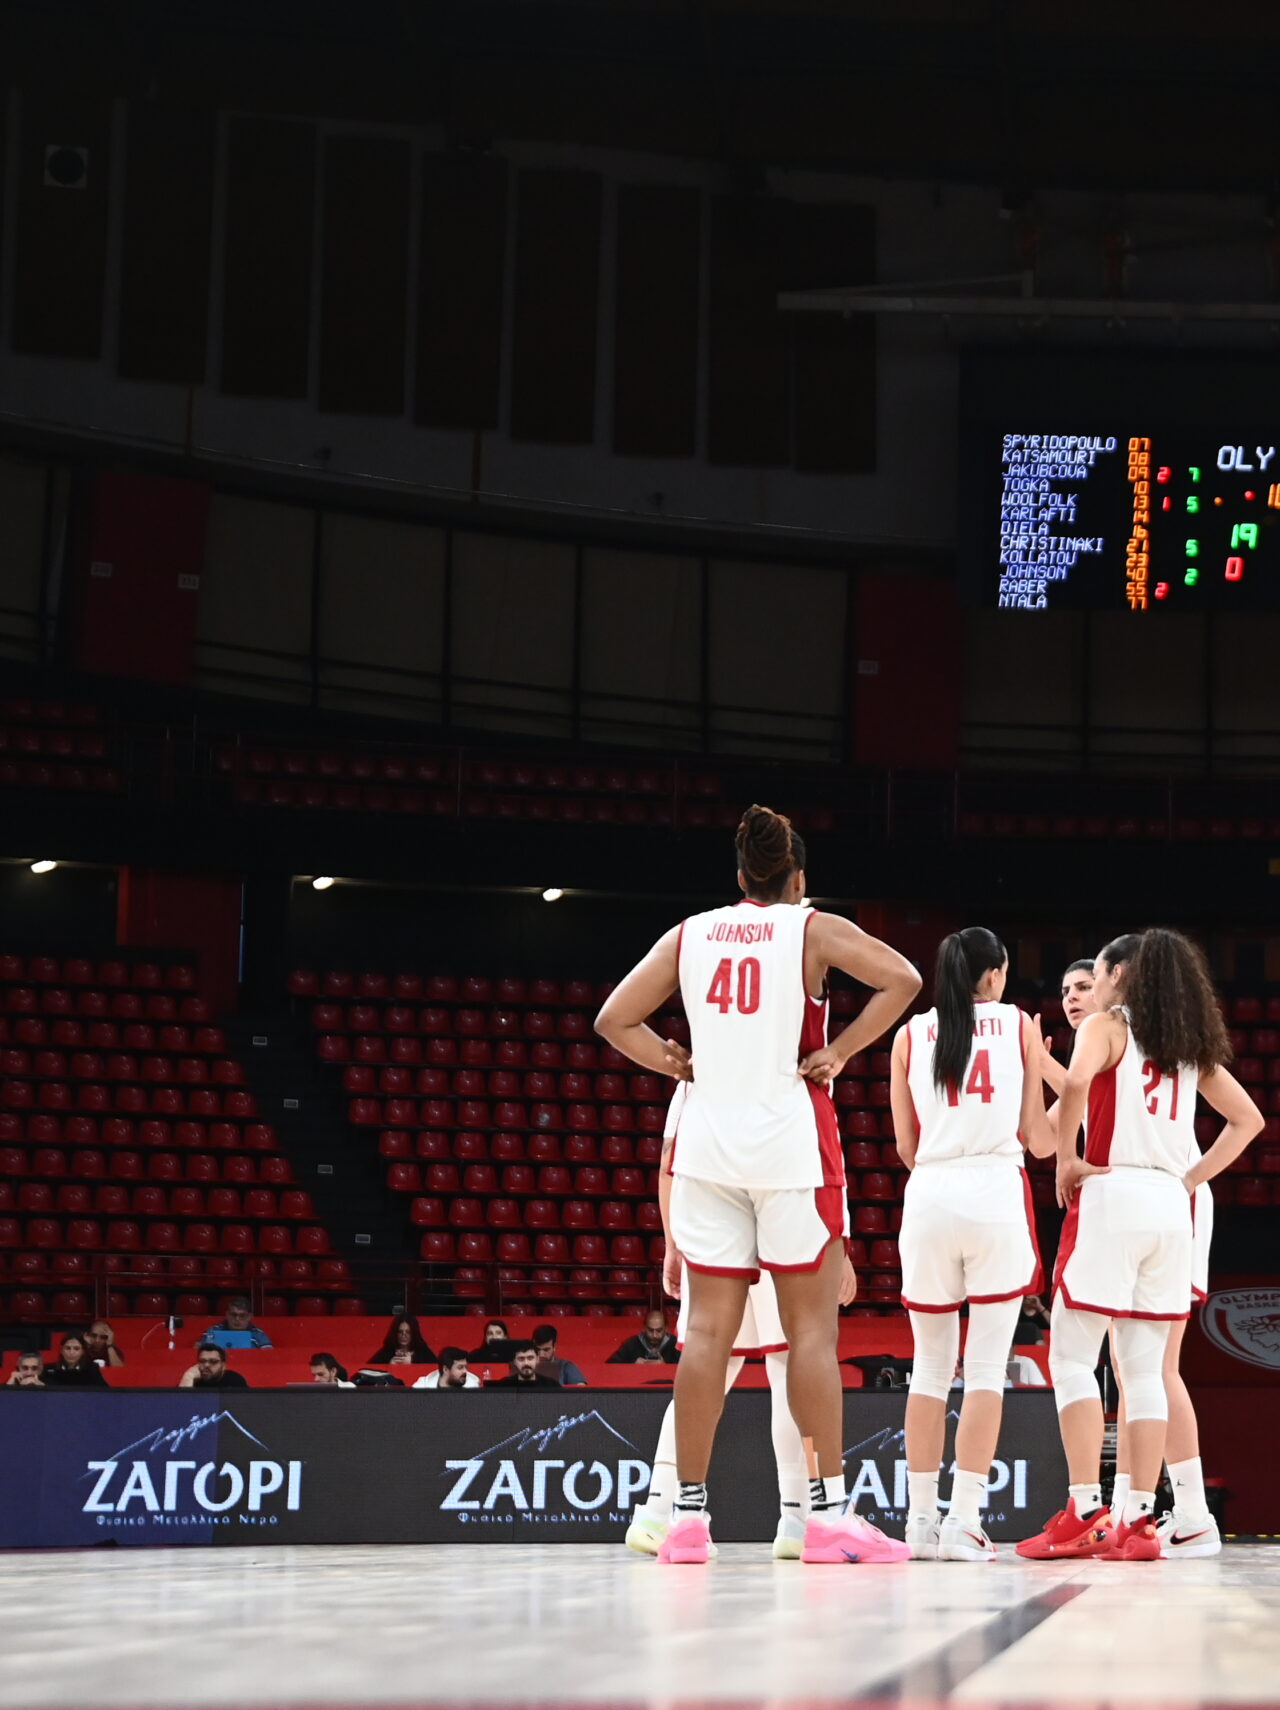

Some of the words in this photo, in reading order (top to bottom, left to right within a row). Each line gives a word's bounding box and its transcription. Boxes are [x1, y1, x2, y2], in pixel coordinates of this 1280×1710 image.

[1002, 434, 1116, 451] SPYRIDOPOULO
[1128, 437, 1150, 450] 07
[1002, 449, 1095, 464] KATSAMOURI
[1128, 452, 1149, 465] 08
[1216, 445, 1275, 471] OLY
[1001, 464, 1087, 479] JAKUBCOVA
[1127, 466, 1149, 481] 09
[1157, 466, 1171, 483] 2
[1188, 466, 1199, 483] 7
[1003, 478, 1049, 492] TOGKA
[1133, 480, 1149, 495] 10
[1001, 492, 1077, 507] WOOLFOLK
[1133, 495, 1148, 509] 13
[1162, 496, 1171, 511] 1
[1186, 495, 1199, 513] 5
[1001, 507, 1075, 521] KARLAFTI
[1133, 510, 1148, 524] 14
[1001, 521, 1049, 536] DIELA
[1132, 525, 1148, 539] 16
[1230, 523, 1258, 550] 19
[1000, 536, 1104, 551] CHRISTINAKI
[1126, 538, 1148, 553] 21
[1185, 538, 1199, 557] 5
[1000, 550, 1077, 565] KOLLATOU
[1126, 553, 1148, 567] 23
[1225, 556, 1244, 581] 0
[1000, 565, 1067, 580] JOHNSON
[1126, 567, 1147, 581] 40
[1184, 567, 1198, 586] 2
[999, 579, 1047, 593] RABER
[1126, 582, 1146, 596] 55
[1154, 582, 1170, 599] 2
[999, 594, 1047, 608] NTALA
[1127, 596, 1147, 610] 77
[707, 922, 774, 944] JOHNSON
[706, 956, 760, 1014] 40
[1141, 1058, 1179, 1121] 21
